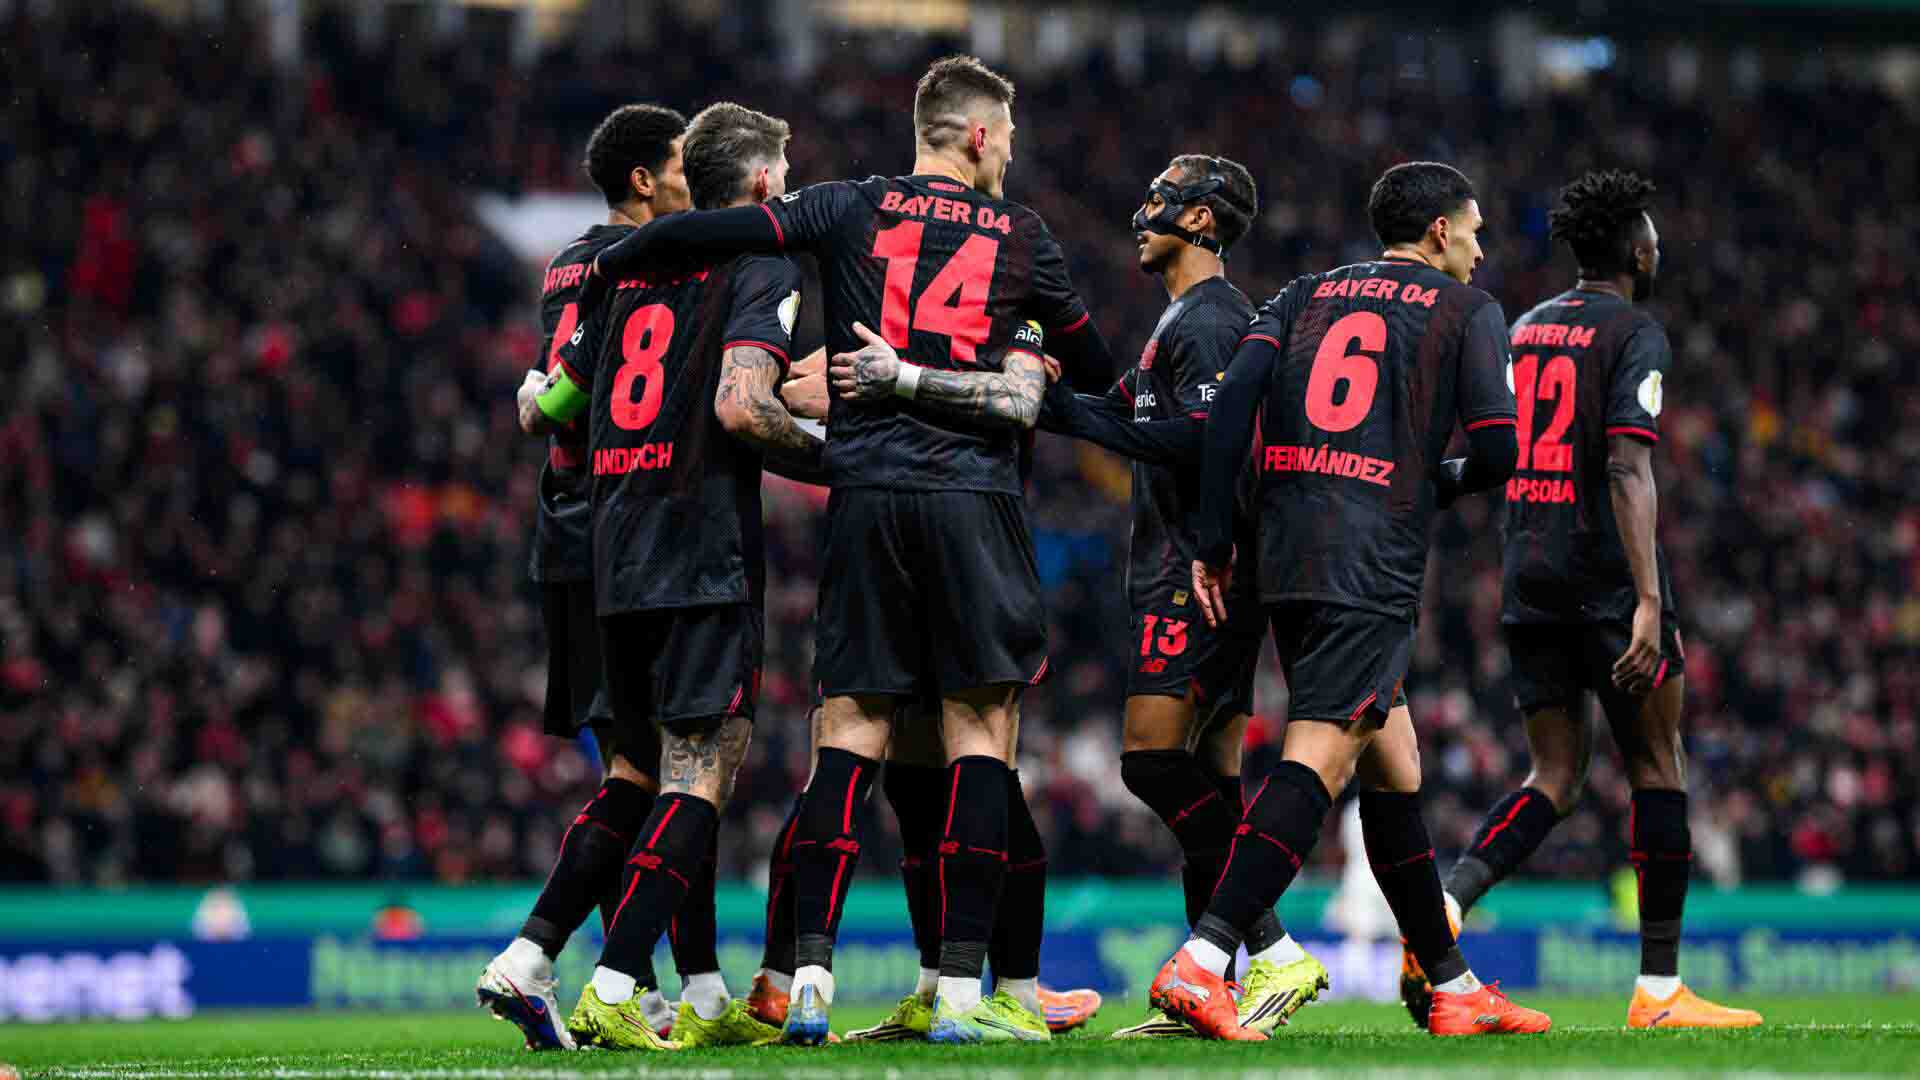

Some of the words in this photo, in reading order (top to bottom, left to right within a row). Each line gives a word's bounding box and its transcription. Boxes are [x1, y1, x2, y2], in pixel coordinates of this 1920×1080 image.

[880, 191, 972, 225] BAYER
[977, 207, 1013, 235] 04
[872, 219, 999, 362] 14
[1312, 277, 1399, 300] BAYER
[1400, 283, 1439, 308] 04
[1567, 325, 1597, 348] 04
[610, 303, 675, 431] 8
[1305, 311, 1388, 433] 6
[1512, 353, 1577, 473] 12
[1263, 443, 1395, 488] FERNÁNDEZ
[1140, 613, 1190, 657] 13
